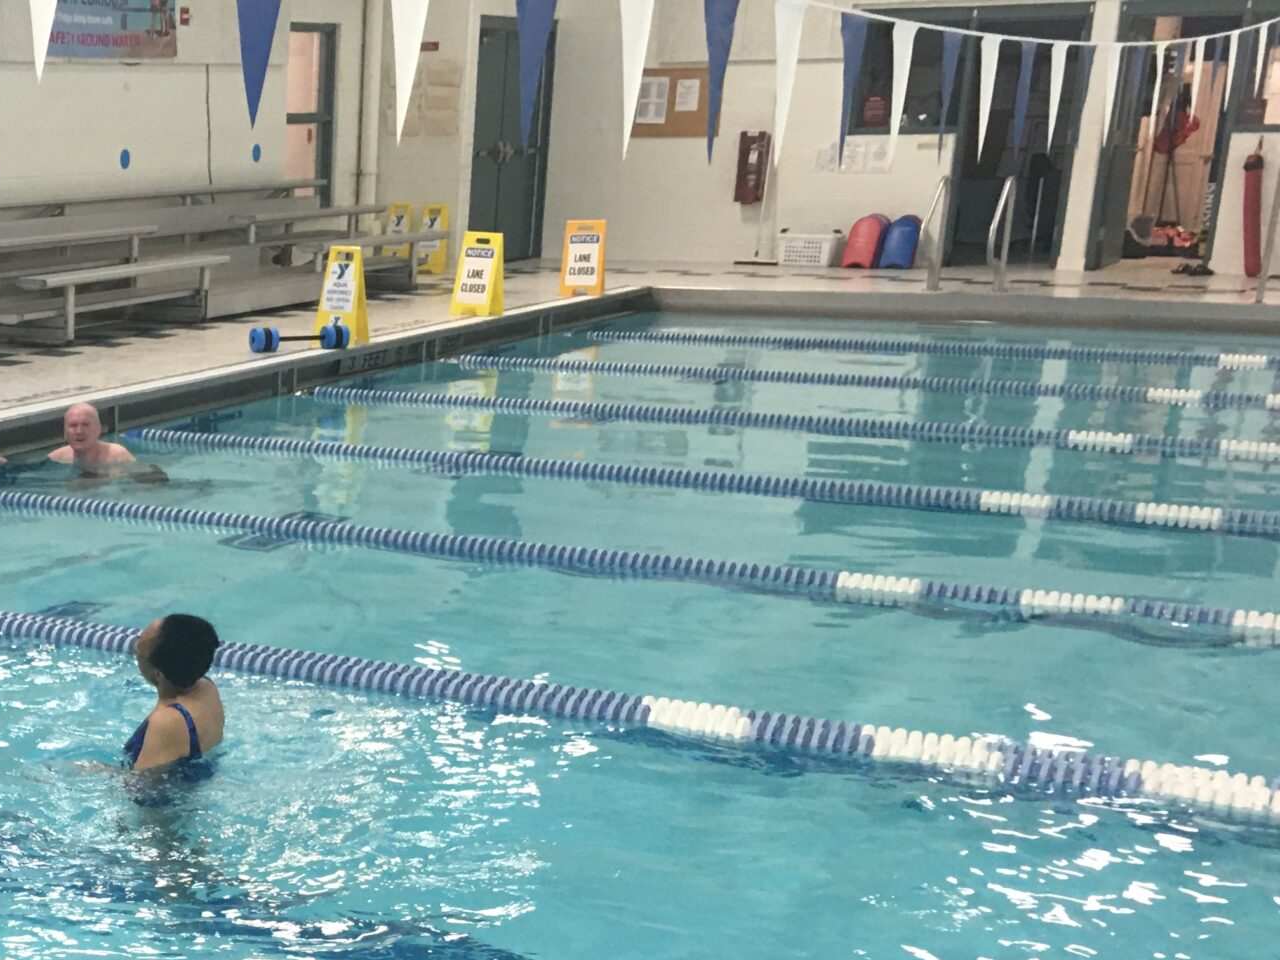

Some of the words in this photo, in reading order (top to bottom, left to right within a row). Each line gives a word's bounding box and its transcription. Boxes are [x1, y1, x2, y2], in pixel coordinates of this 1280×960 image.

[50, 31, 76, 45] AFETY
[570, 234, 599, 243] NOTICE
[466, 248, 494, 258] NOTICE
[574, 254, 591, 263] LANE
[466, 268, 485, 279] LANE
[568, 267, 596, 276] CLOSED
[460, 283, 487, 294] CLOSED
